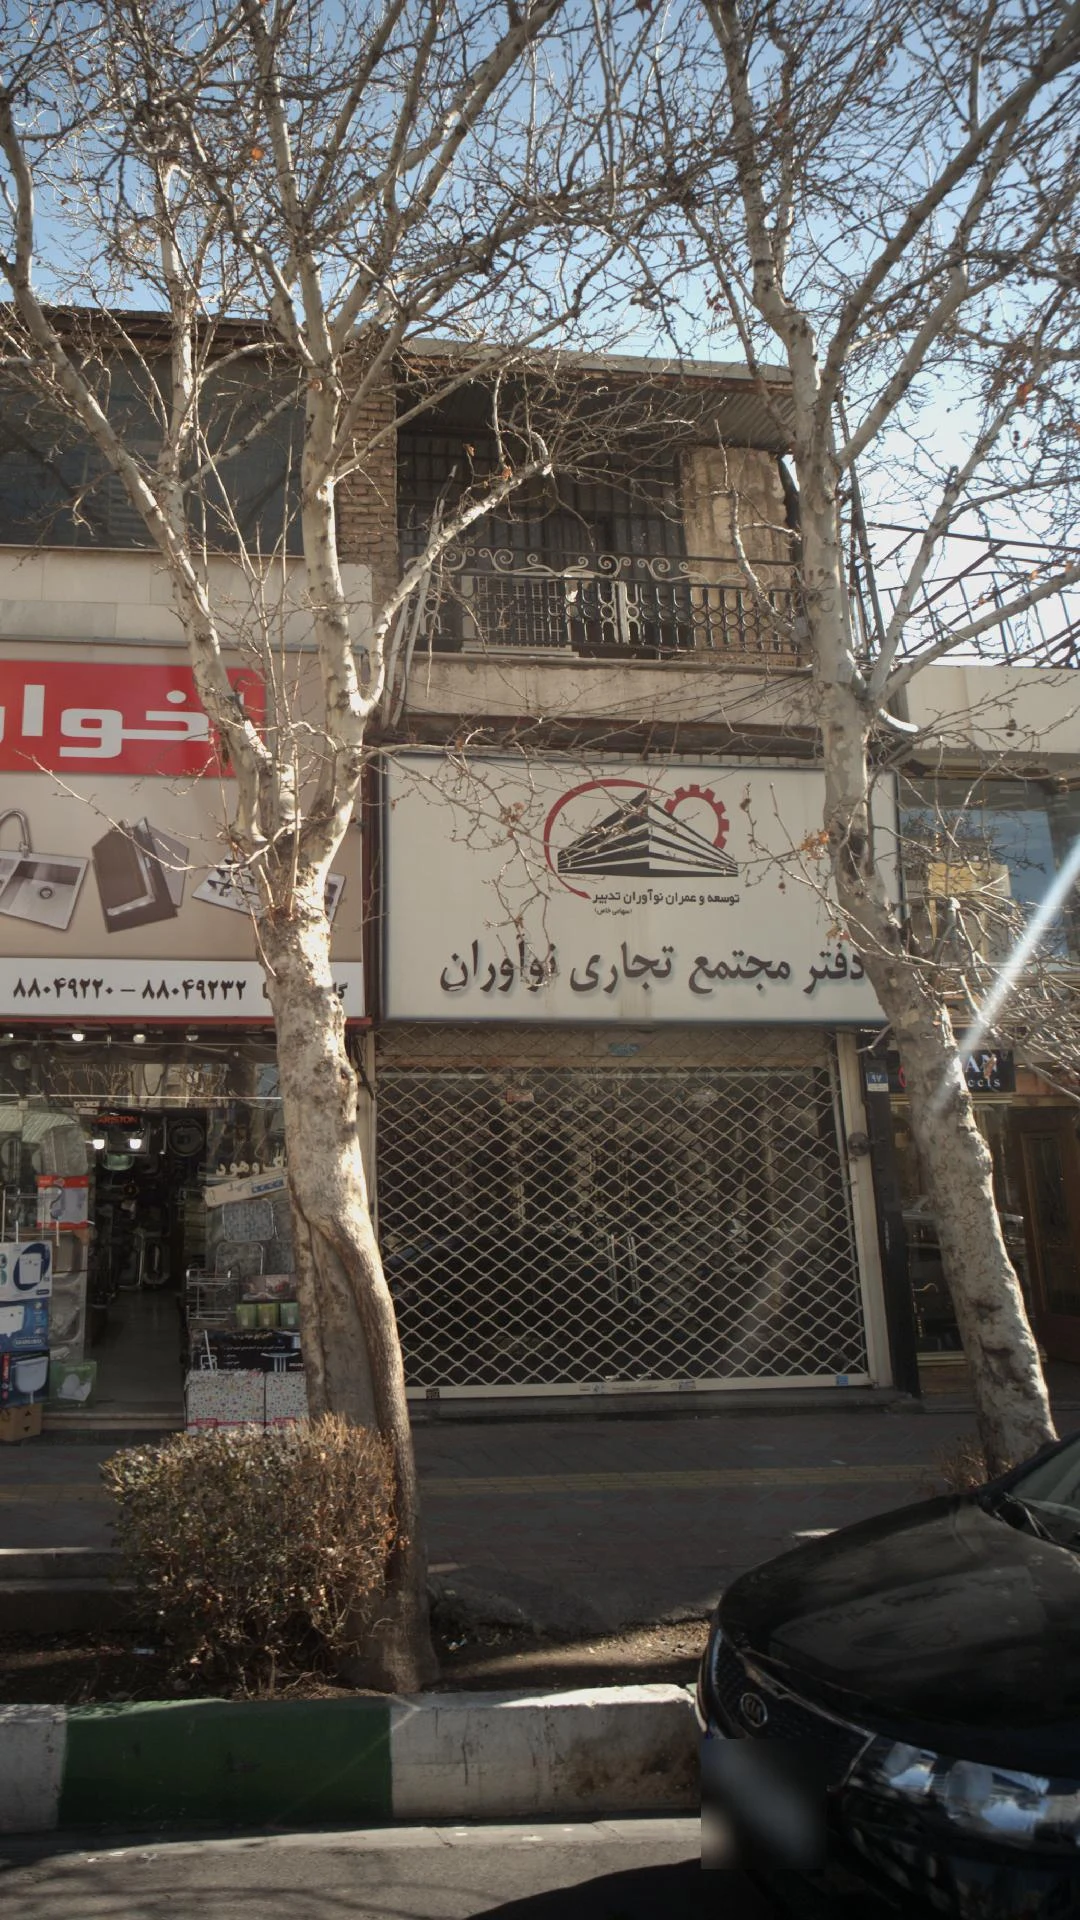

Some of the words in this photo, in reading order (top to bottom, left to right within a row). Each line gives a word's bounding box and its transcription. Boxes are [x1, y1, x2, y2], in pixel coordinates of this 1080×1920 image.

[0, 684, 244, 759] خوا
[592, 891, 621, 904] تدبیر
[623, 889, 664, 905] نوآوران
[665, 892, 697, 906] عمران
[698, 894, 705, 906] و
[707, 893, 740, 906] توسعه
[570, 941, 675, 994] تجاری
[688, 950, 791, 995] مجتمع
[803, 942, 865, 994] دفتر
[13, 977, 114, 999] ۸۸۰۴۹۲۲۰
[142, 978, 246, 1000] ۸۸۰۴۹۲۳۲
